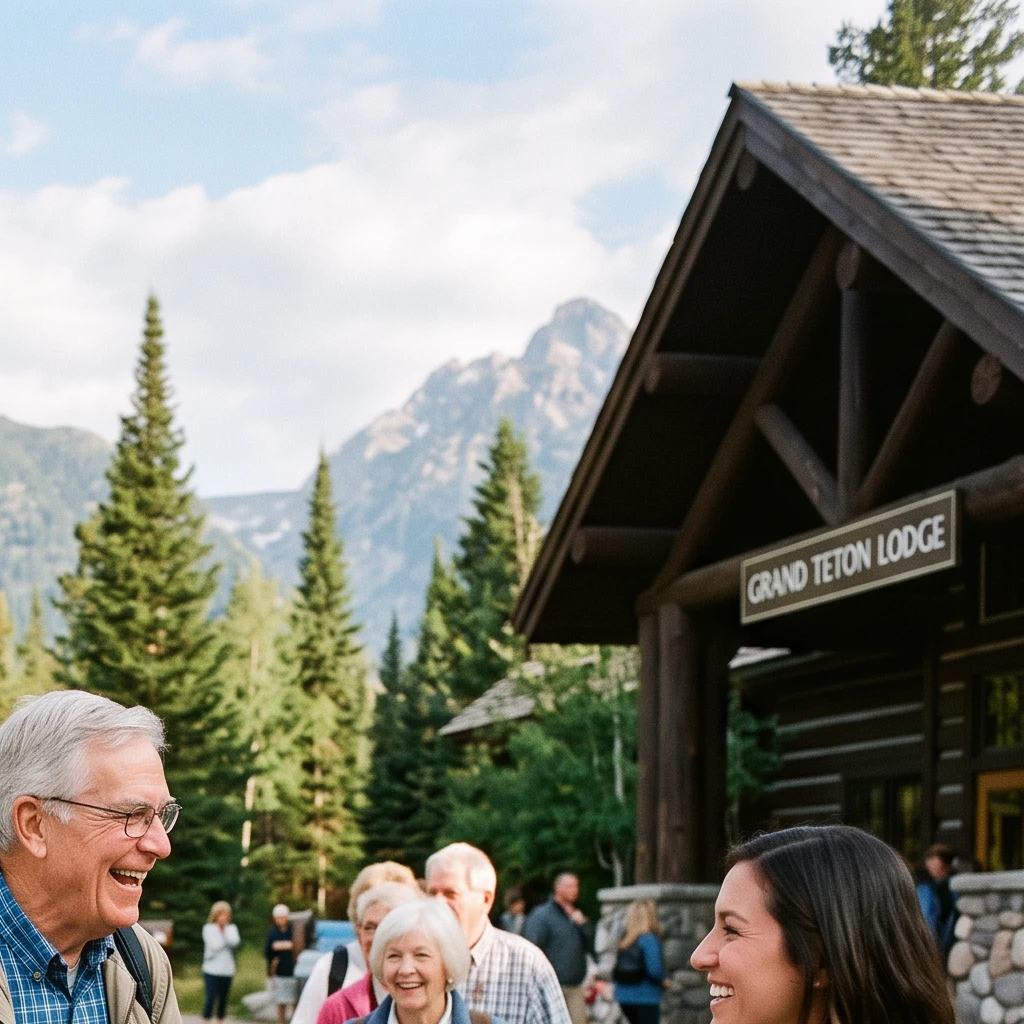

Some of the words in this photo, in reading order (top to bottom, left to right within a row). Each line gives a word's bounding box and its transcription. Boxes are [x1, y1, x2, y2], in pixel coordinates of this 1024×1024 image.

[747, 559, 809, 605] GRAND
[810, 537, 872, 586] TETON
[877, 513, 946, 567] LODGE
